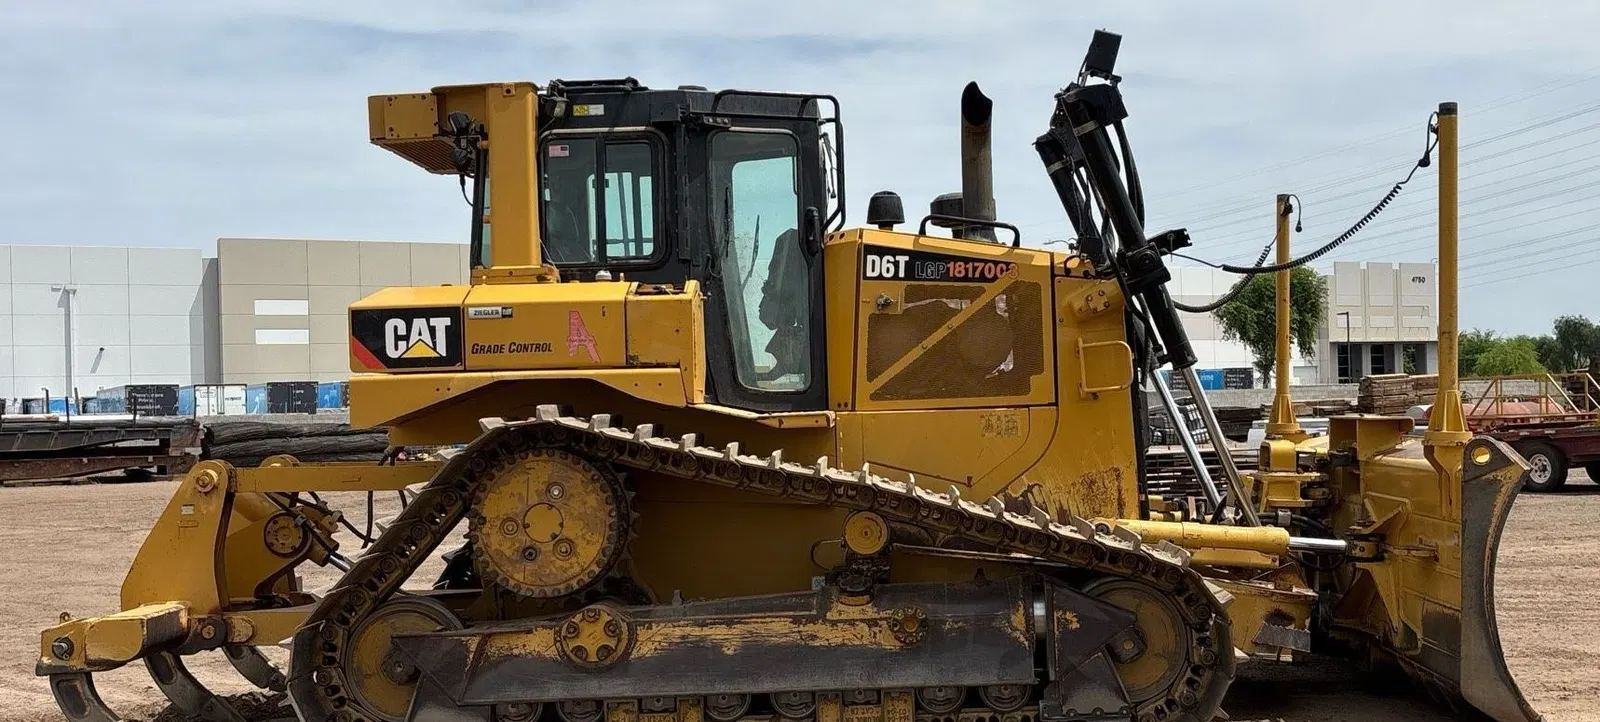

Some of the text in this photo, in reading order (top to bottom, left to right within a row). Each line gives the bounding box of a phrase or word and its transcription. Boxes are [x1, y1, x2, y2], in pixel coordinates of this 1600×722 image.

[866, 254, 1020, 280] D6T LGP 1817003
[1411, 276, 1426, 284] 4750
[384, 317, 451, 359] CAT
[471, 341, 553, 355] GRADE CONTROL
